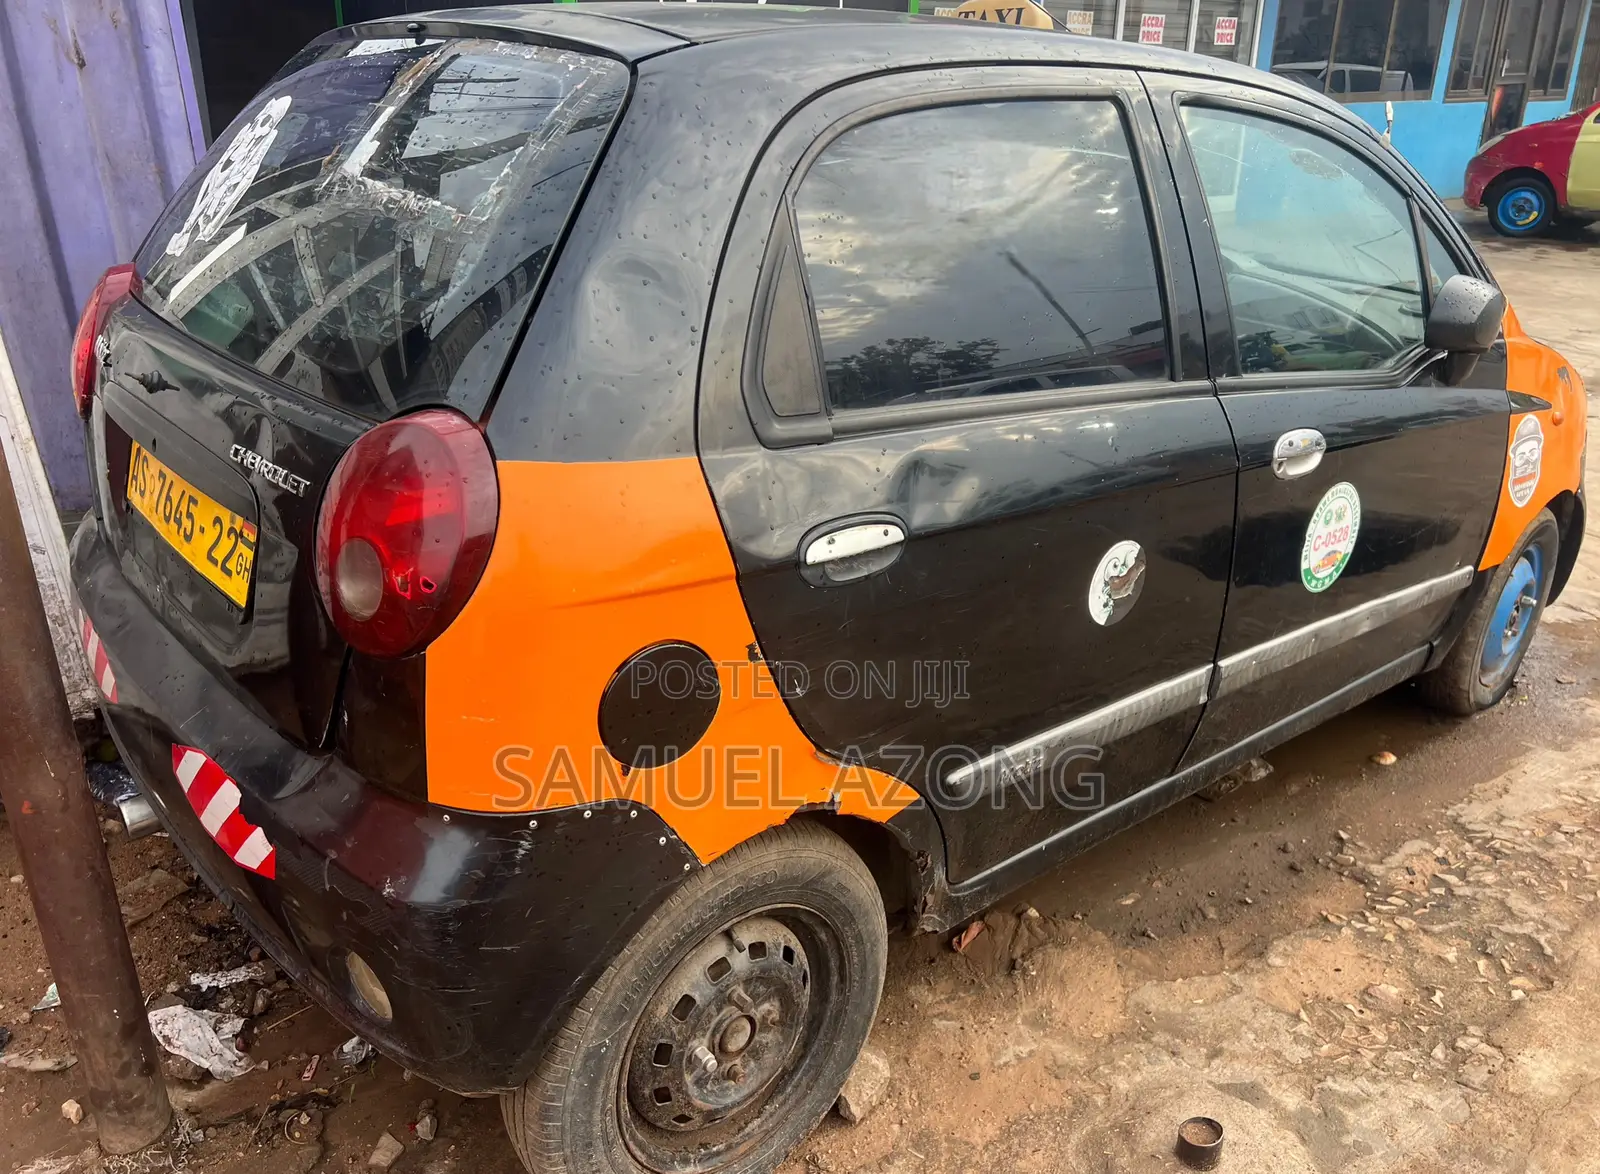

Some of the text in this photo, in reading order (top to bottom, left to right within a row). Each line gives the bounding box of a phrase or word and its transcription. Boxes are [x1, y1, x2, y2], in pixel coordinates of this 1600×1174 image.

[1143, 15, 1164, 28] ACCRA
[1215, 18, 1236, 30] ACCRA
[1141, 30, 1161, 42] PRICE
[1215, 32, 1234, 43] PRICE
[130, 444, 149, 499] AS
[229, 443, 310, 497] CHEVROLET
[1312, 524, 1350, 552] C-0528
[235, 552, 252, 584] GH
